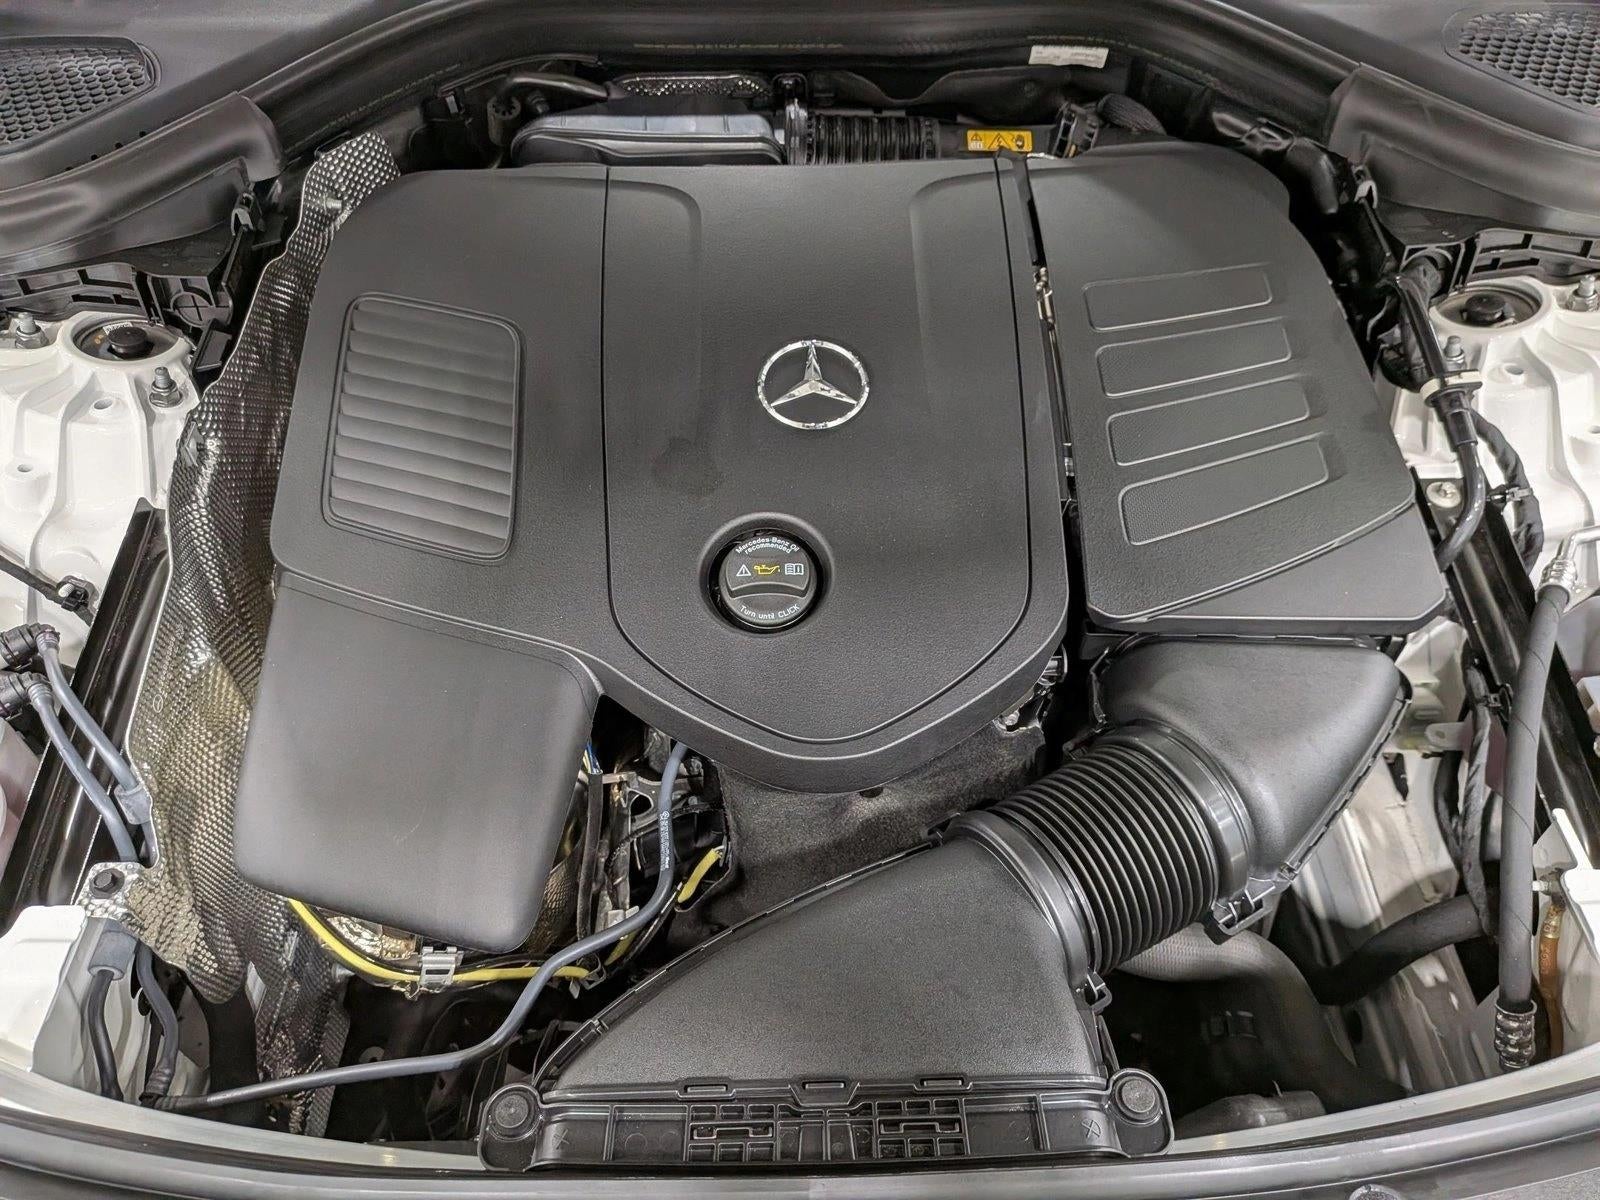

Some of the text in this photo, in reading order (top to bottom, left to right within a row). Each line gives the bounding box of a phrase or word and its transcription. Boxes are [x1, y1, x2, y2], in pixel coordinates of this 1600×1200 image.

[735, 537, 800, 554] Mercedes-Benz Oil
[744, 542, 793, 555] recommended
[740, 604, 756, 617] Turn
[777, 604, 800, 618] CLICK
